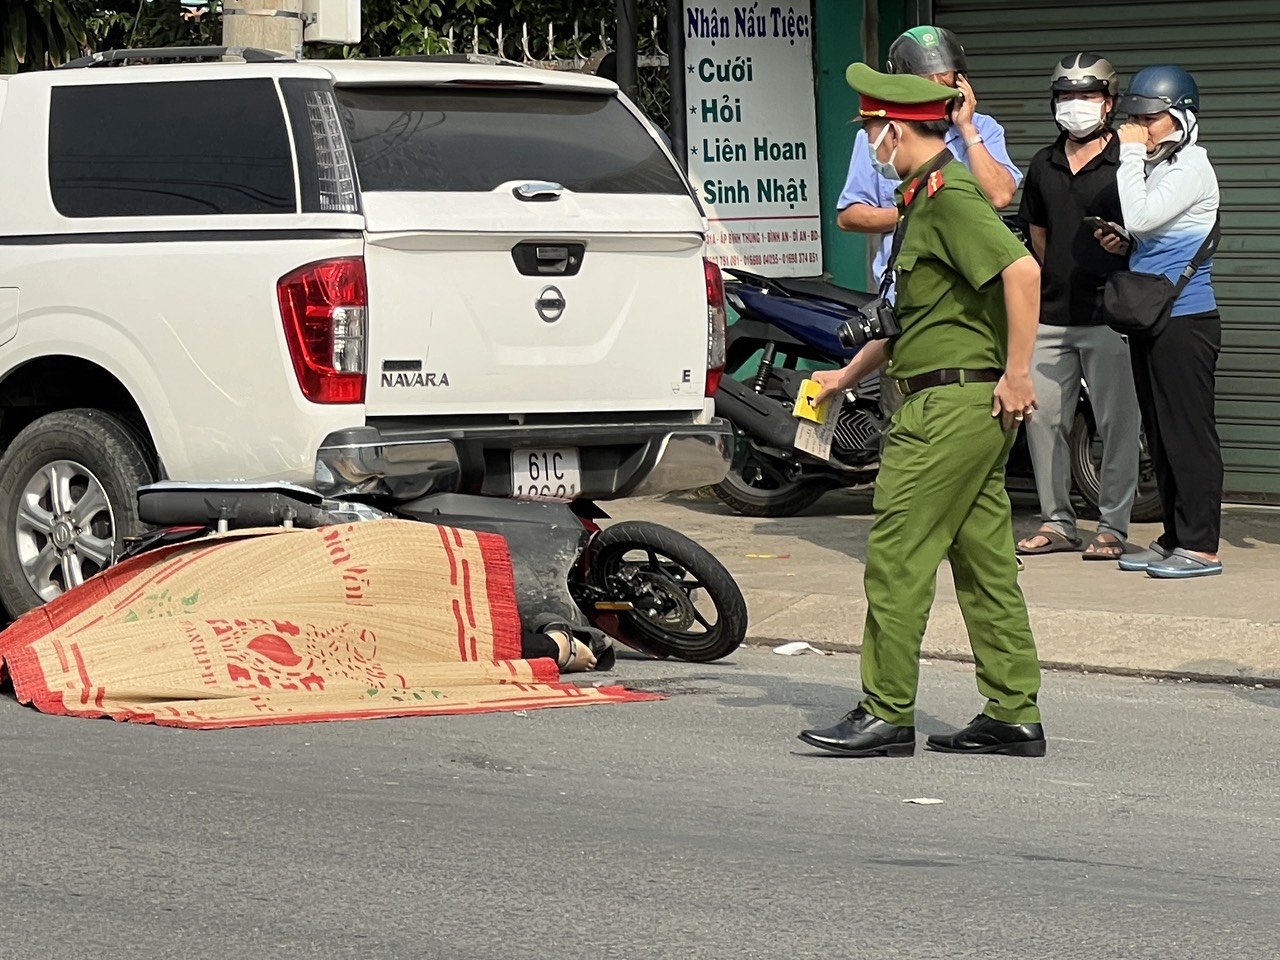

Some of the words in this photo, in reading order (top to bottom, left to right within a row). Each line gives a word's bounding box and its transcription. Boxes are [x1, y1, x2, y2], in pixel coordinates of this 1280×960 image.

[687, 7, 730, 47] Nhận
[734, 1, 766, 38] Nấu
[698, 56, 753, 83] Cưới
[701, 94, 742, 123] Hỏi
[703, 138, 747, 163] Liên
[753, 137, 807, 161] Hoan
[703, 179, 750, 205] Sinh
[757, 178, 808, 209] Nhật
[381, 373, 449, 387] NAVARA
[682, 369, 691, 383] E
[528, 452, 564, 481] 61C
